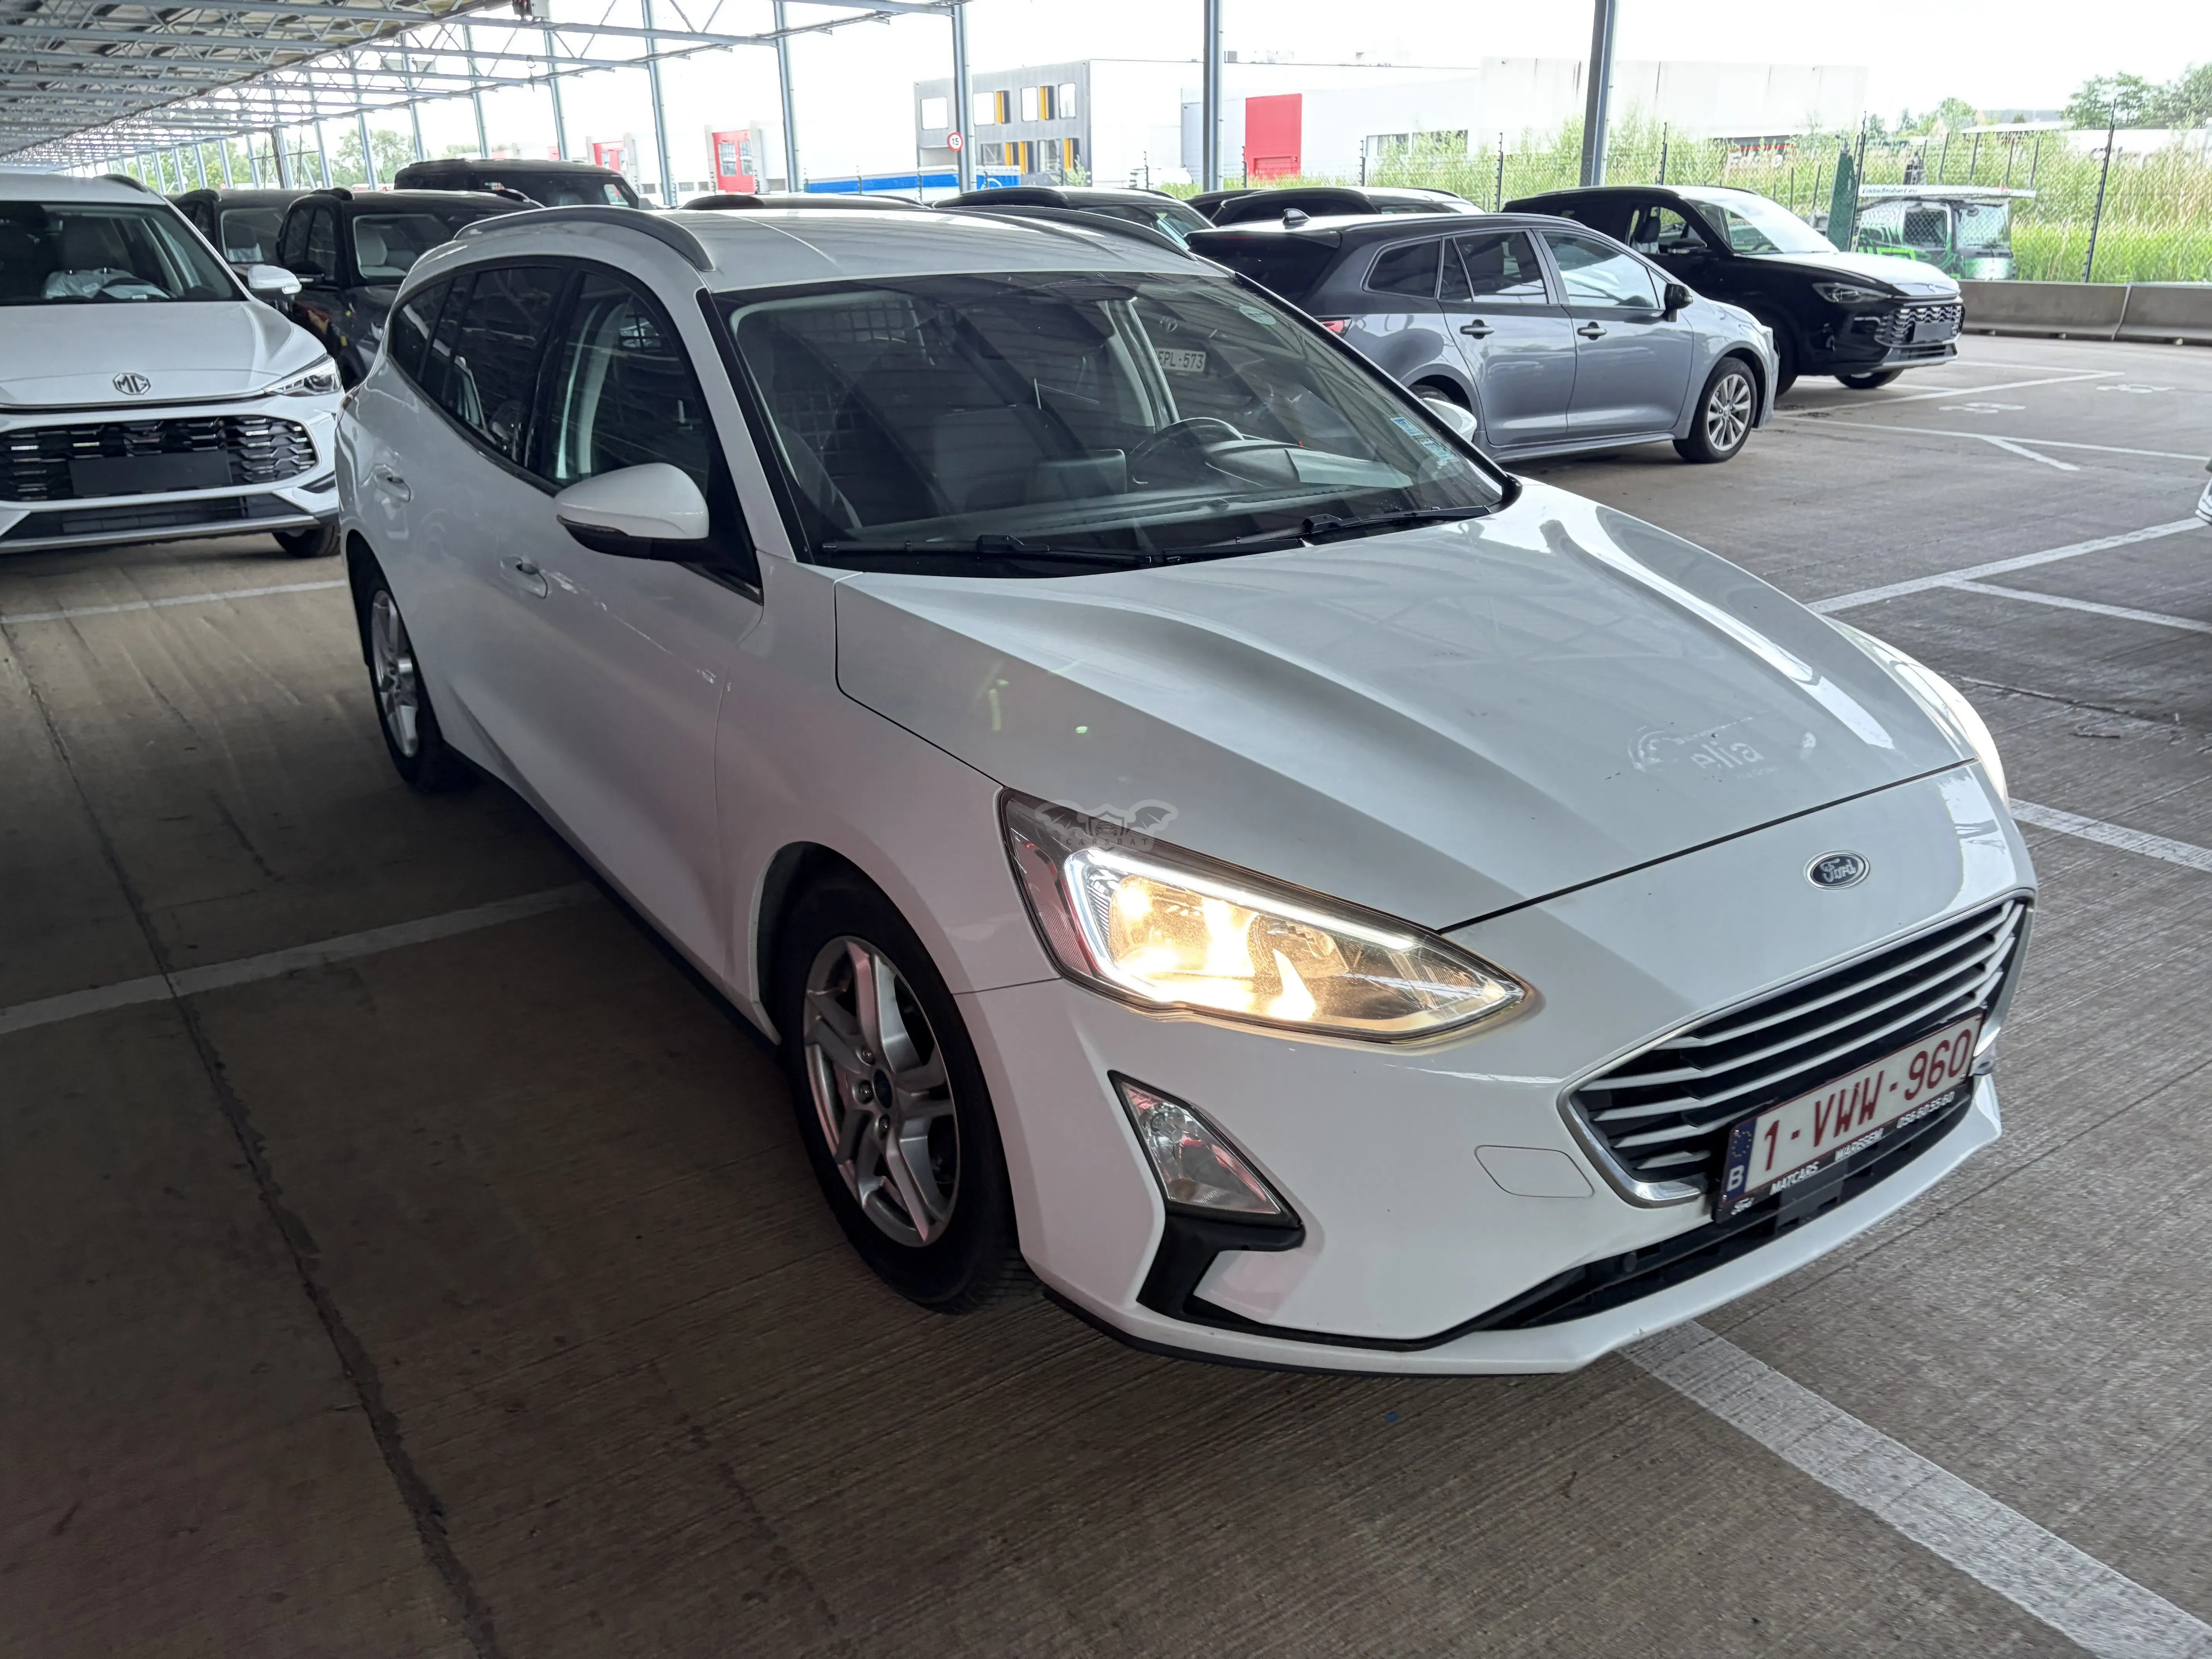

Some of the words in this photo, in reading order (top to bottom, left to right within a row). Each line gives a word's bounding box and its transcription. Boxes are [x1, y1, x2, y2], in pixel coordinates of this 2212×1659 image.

[952, 137, 959, 146] 15
[117, 375, 148, 393] MG
[1820, 858, 1856, 883] Ford
[1764, 1029, 1972, 1171] 1-VWW-960
[1726, 1164, 1745, 1192] B
[1769, 1161, 1819, 1195] MATCARS
